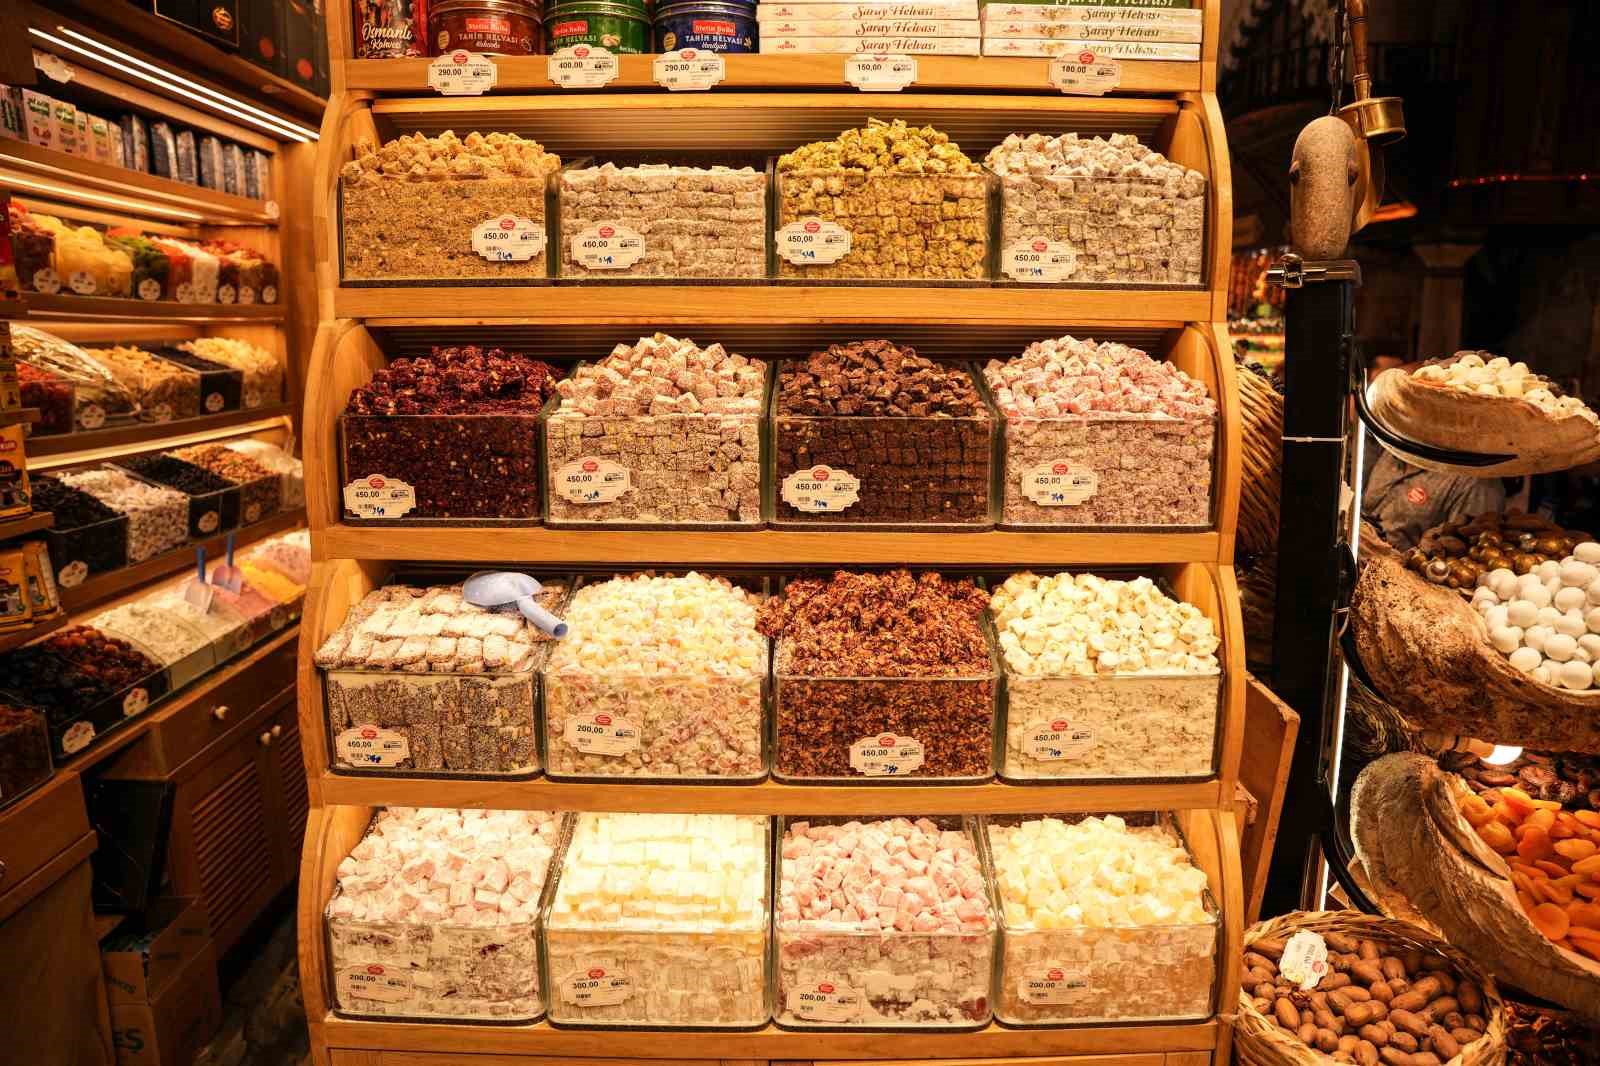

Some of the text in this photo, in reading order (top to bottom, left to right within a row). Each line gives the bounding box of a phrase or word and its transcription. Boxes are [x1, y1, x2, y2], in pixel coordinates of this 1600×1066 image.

[853, 6, 888, 20] Saray
[1081, 8, 1115, 21] Saray
[855, 23, 891, 37] Saray
[1080, 25, 1115, 40] Saray
[856, 39, 892, 52] Saray
[558, 62, 583, 70] 400,00
[664, 64, 690, 72] 290,00
[787, 235, 814, 243] 450,00
[577, 725, 604, 734] 200,00
